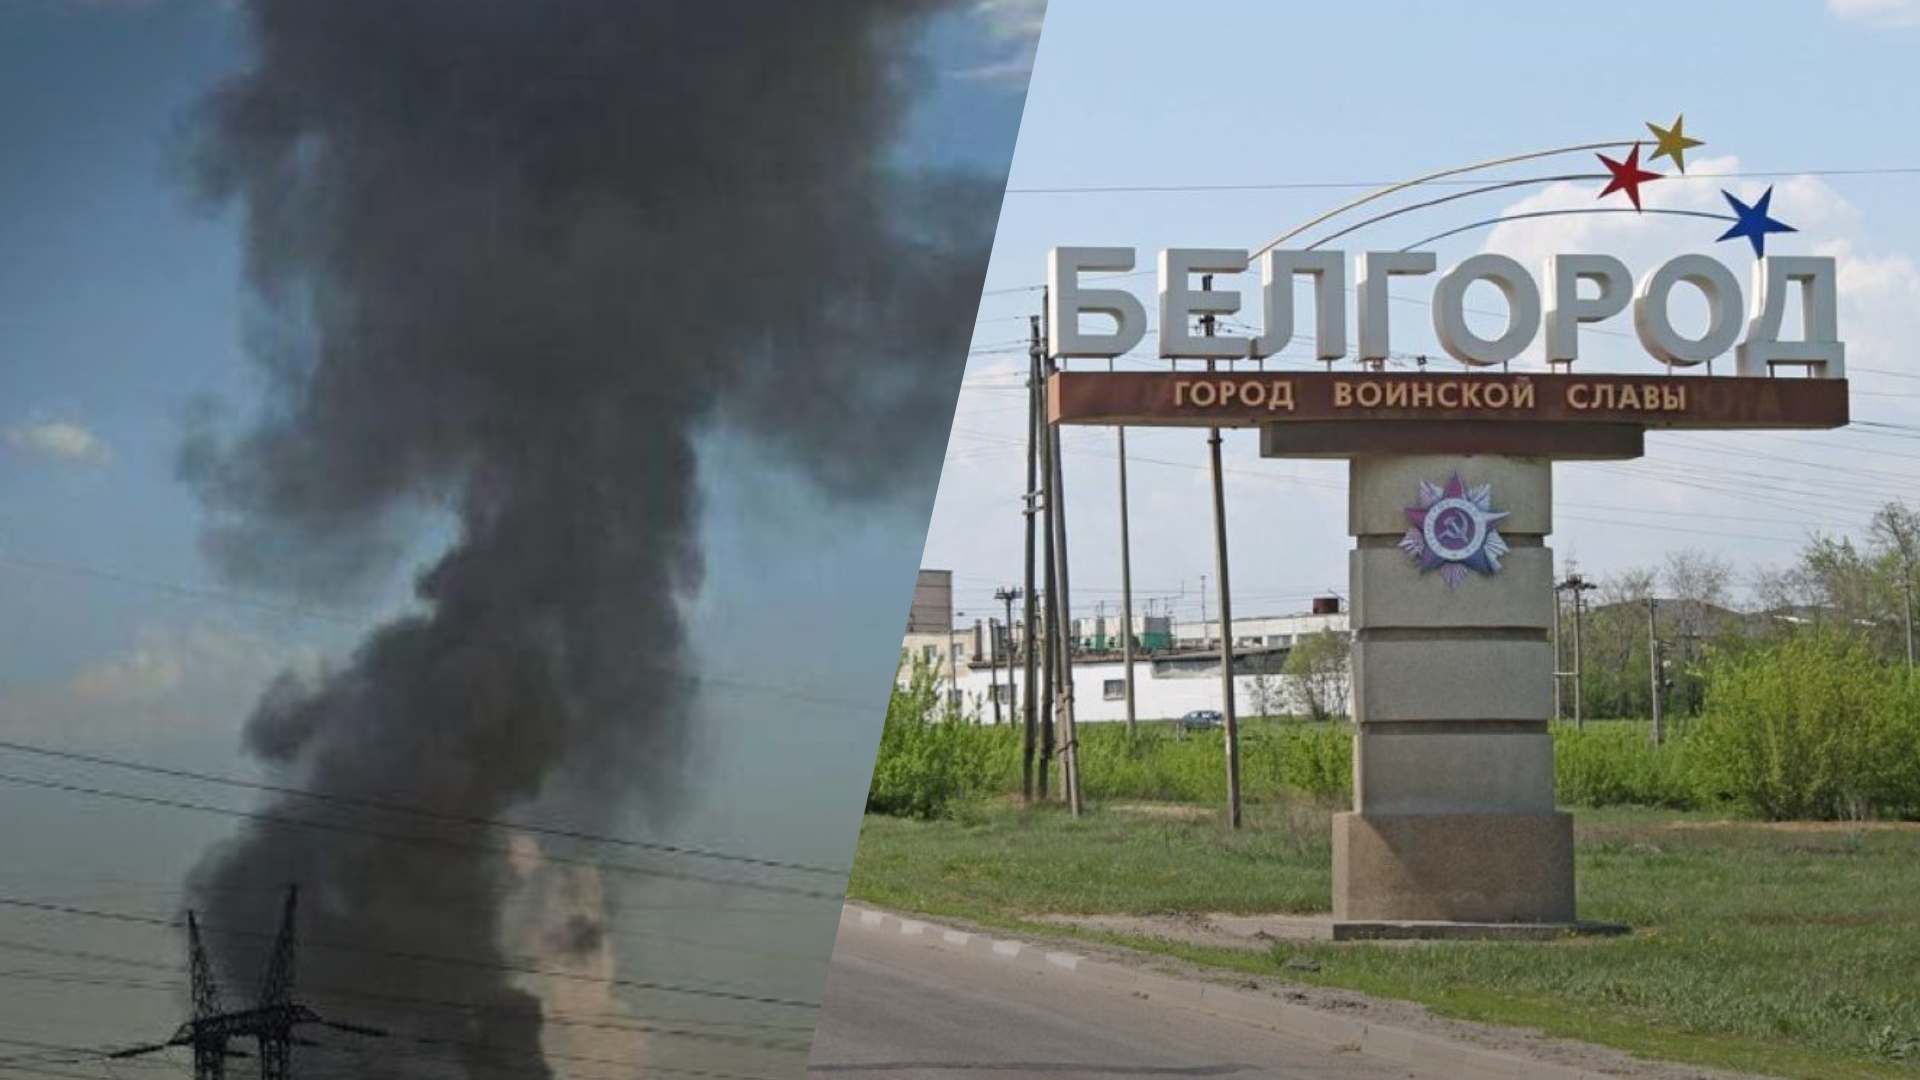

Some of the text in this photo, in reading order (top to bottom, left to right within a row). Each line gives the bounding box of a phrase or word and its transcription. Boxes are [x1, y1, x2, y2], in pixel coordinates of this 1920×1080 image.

[1048, 246, 1844, 378] БЕЛГОРОД
[1173, 380, 1294, 411] ГОРОД
[1334, 376, 1535, 409] ВОИНСКОЙ
[1566, 382, 1686, 411] СЛАВЫ
